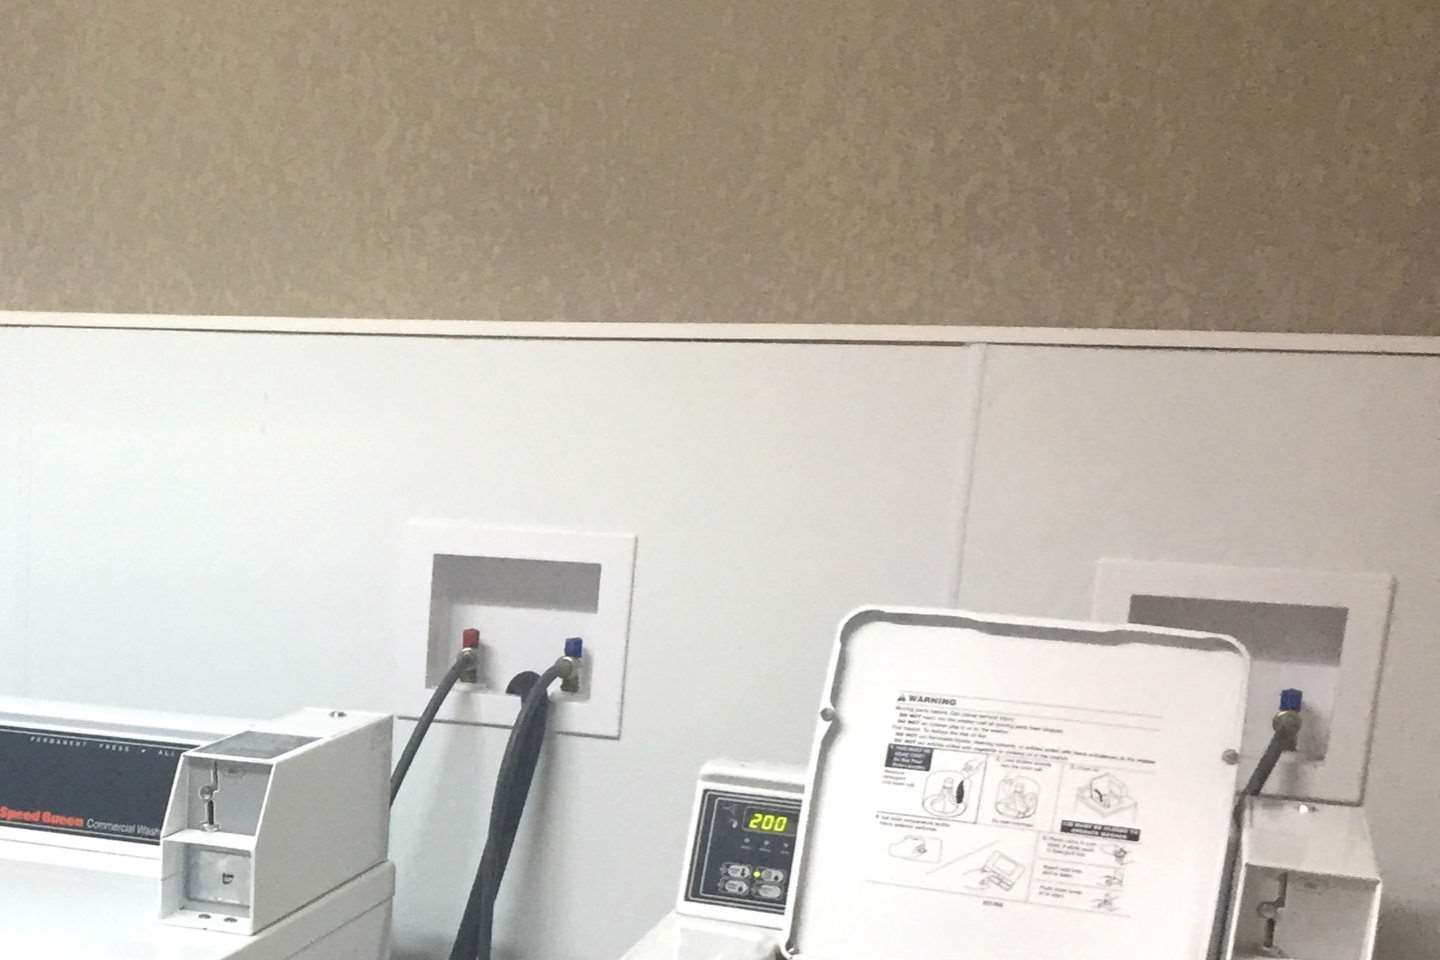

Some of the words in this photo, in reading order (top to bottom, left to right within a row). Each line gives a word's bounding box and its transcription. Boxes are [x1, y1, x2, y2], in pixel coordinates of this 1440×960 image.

[908, 694, 957, 706] WARNING
[0, 805, 41, 821] Speed
[41, 810, 84, 828] Queen
[87, 818, 136, 834] Commercial
[748, 812, 788, 832] 200
